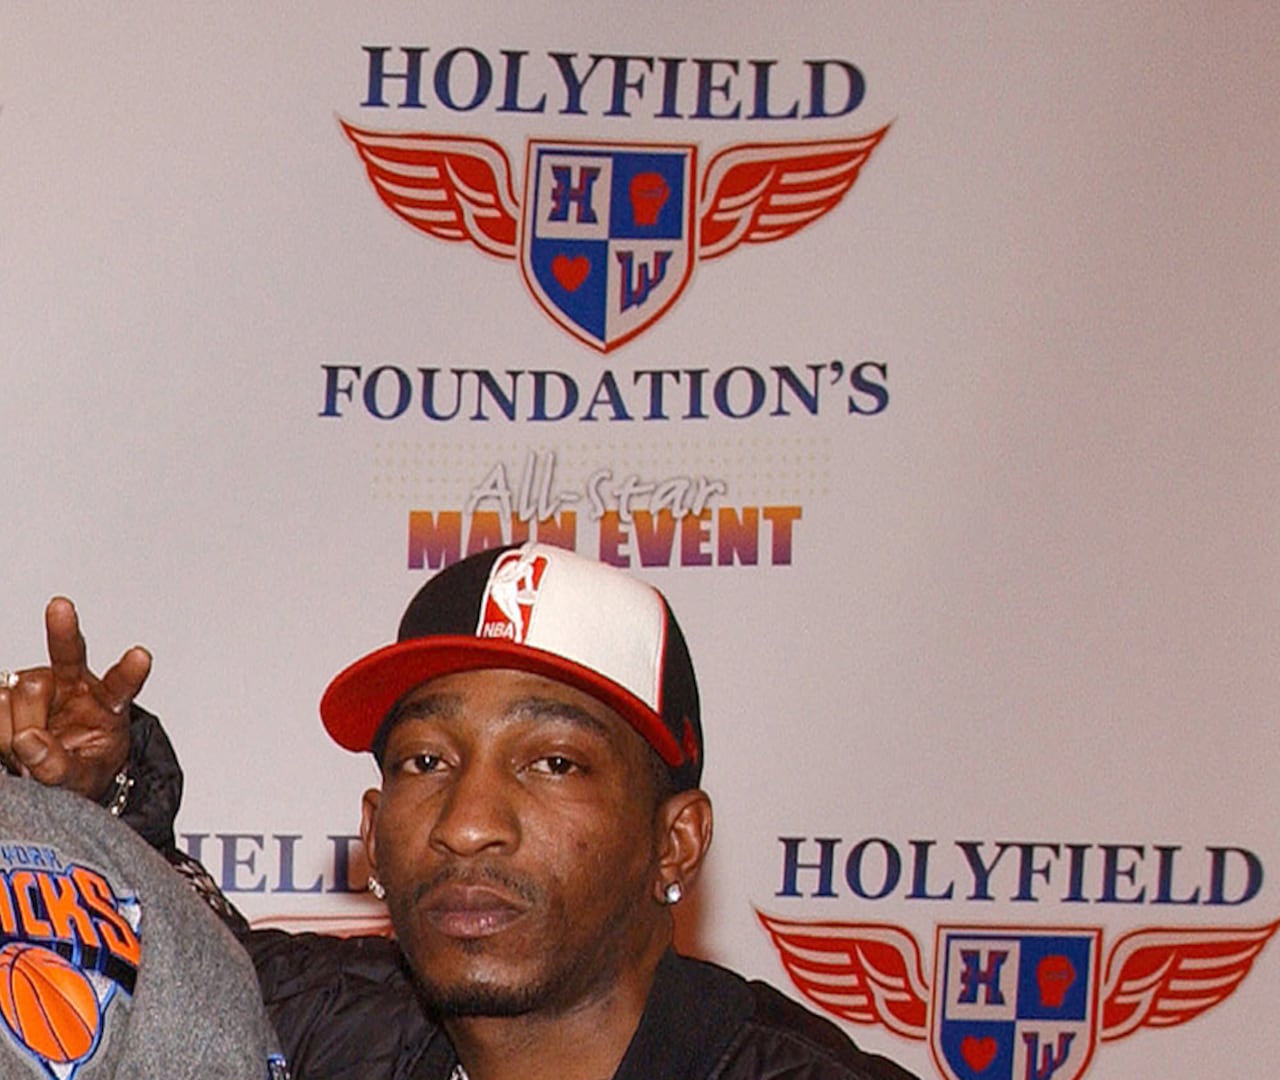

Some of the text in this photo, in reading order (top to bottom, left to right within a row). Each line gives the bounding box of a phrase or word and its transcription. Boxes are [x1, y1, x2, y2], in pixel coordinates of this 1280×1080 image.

[360, 46, 866, 121] HOLYFIELD
[318, 361, 891, 423] FOUNDATION'S
[467, 450, 726, 524] All-Star
[407, 506, 803, 570] MAIN EVENT
[483, 622, 516, 639] NBA
[1, 846, 63, 870] YORK
[774, 836, 1266, 907] HOLYFIELD
